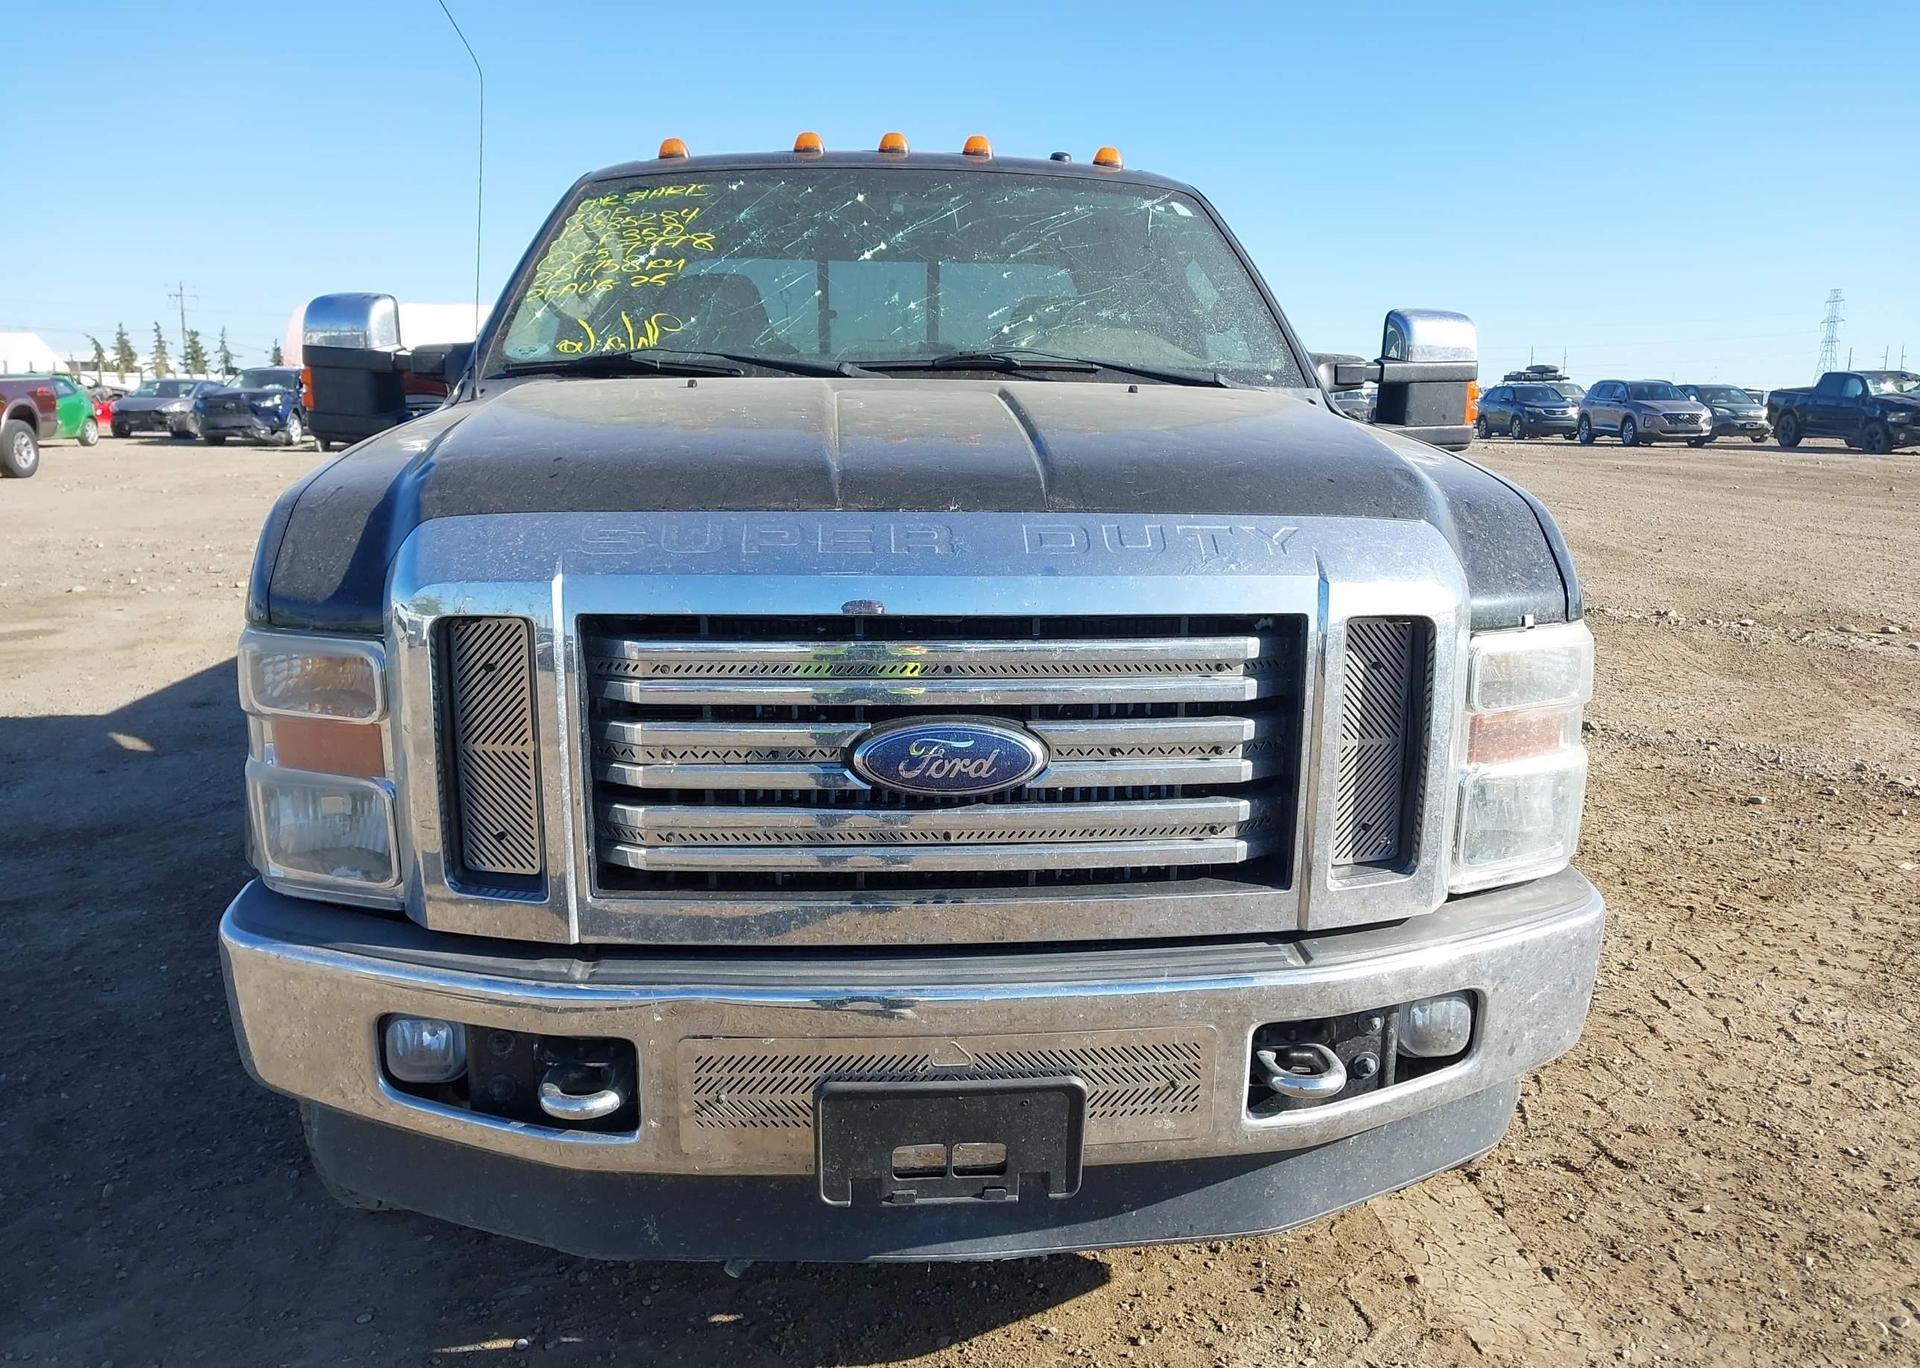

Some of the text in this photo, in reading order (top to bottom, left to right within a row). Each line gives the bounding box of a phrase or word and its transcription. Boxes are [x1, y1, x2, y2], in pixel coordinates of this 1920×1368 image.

[555, 280, 621, 299] AUG
[630, 273, 674, 288] 25
[580, 522, 1300, 555] SUPER DUTY
[898, 736, 998, 780] Ford
